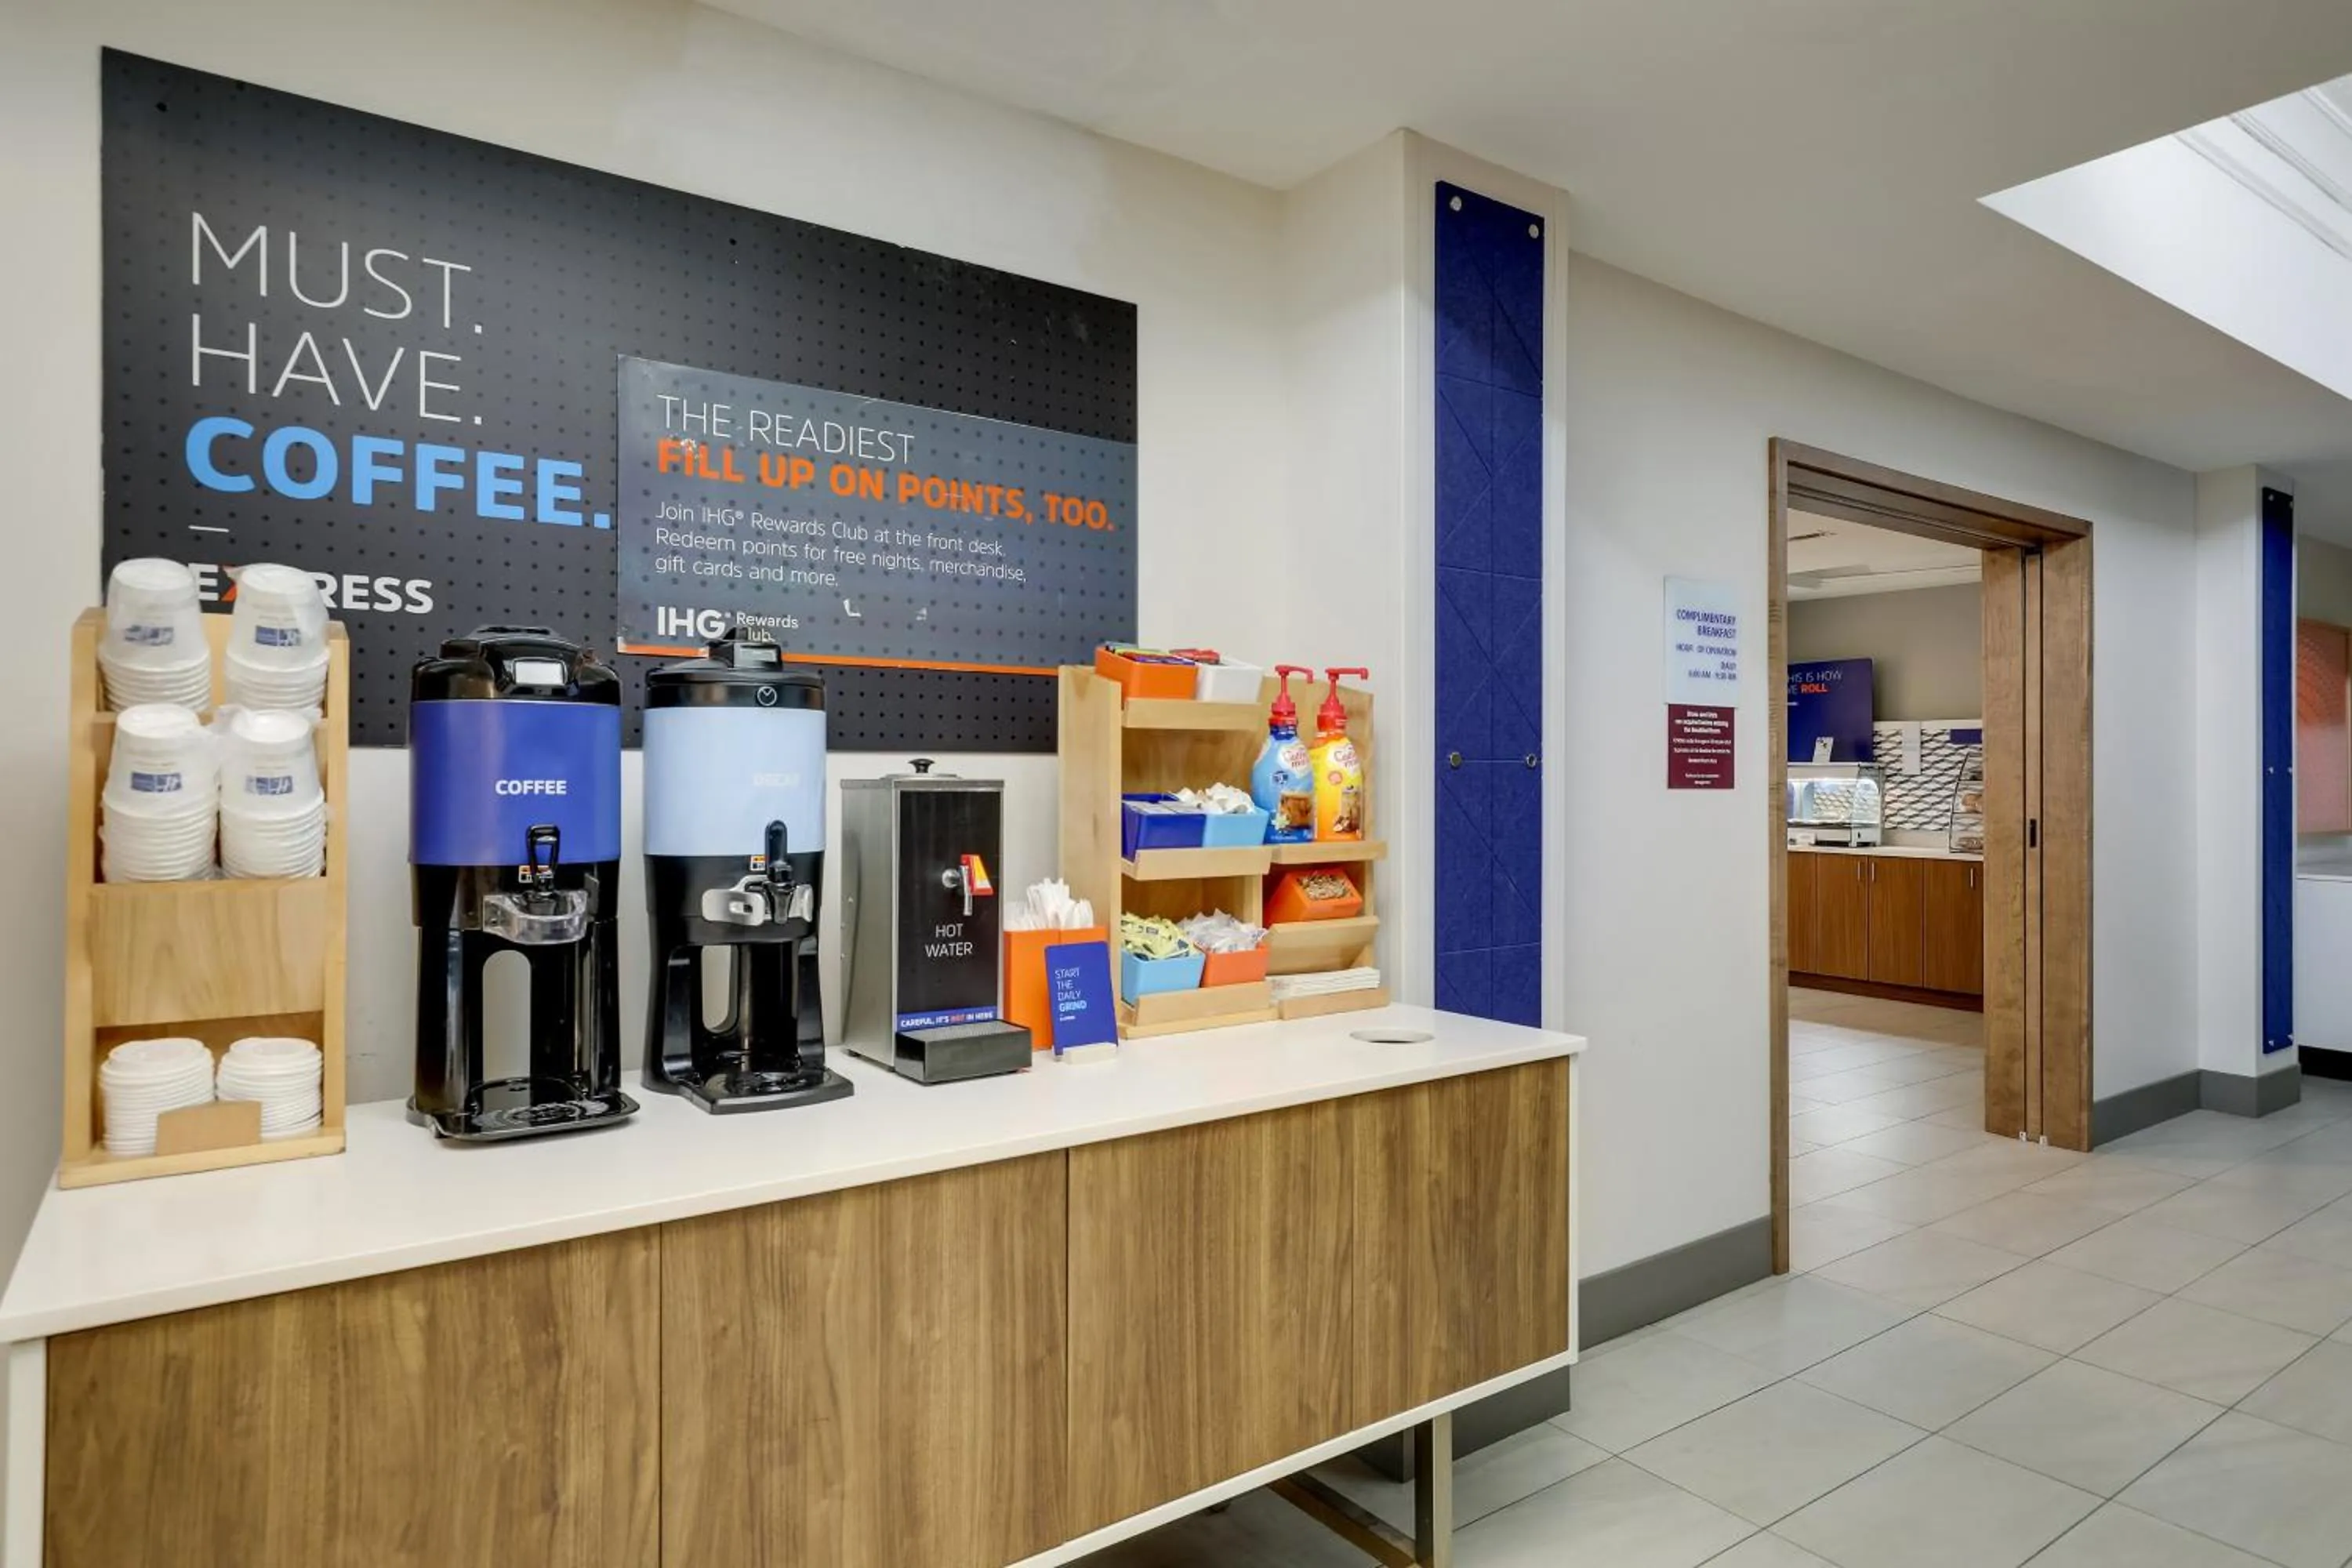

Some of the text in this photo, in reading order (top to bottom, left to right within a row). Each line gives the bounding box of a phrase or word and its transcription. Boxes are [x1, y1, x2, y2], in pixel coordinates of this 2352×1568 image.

[192, 212, 482, 333] MUST.
[192, 314, 482, 425] HAVE.
[657, 394, 915, 465] THE READIEST
[185, 416, 611, 529] COFFEE.
[657, 437, 1115, 532] FILL UP ON POINTS, TOO.
[655, 501, 694, 522] Join
[751, 511, 826, 537] Rewards
[832, 521, 869, 541] Club
[874, 528, 890, 544] at
[896, 529, 922, 546] the
[927, 532, 964, 552] front
[968, 539, 1007, 557] desk.
[656, 527, 1028, 583] Redeem points for free nights, merchandise,
[655, 554, 839, 587] gift cards and more.
[188, 562, 434, 615] ERESS
[735, 611, 799, 629] Rewards
[747, 627, 771, 642] lub
[1788, 672, 1802, 683] HIS
[1800, 683, 1828, 694] ROLL
[495, 779, 567, 795] COFFEE
[935, 923, 964, 938] HOT
[925, 942, 973, 957] WATER
[1054, 967, 1080, 979] START
[1056, 979, 1073, 990] THE
[1058, 990, 1081, 1001] DAILY
[1059, 1000, 1087, 1012] GRIND
